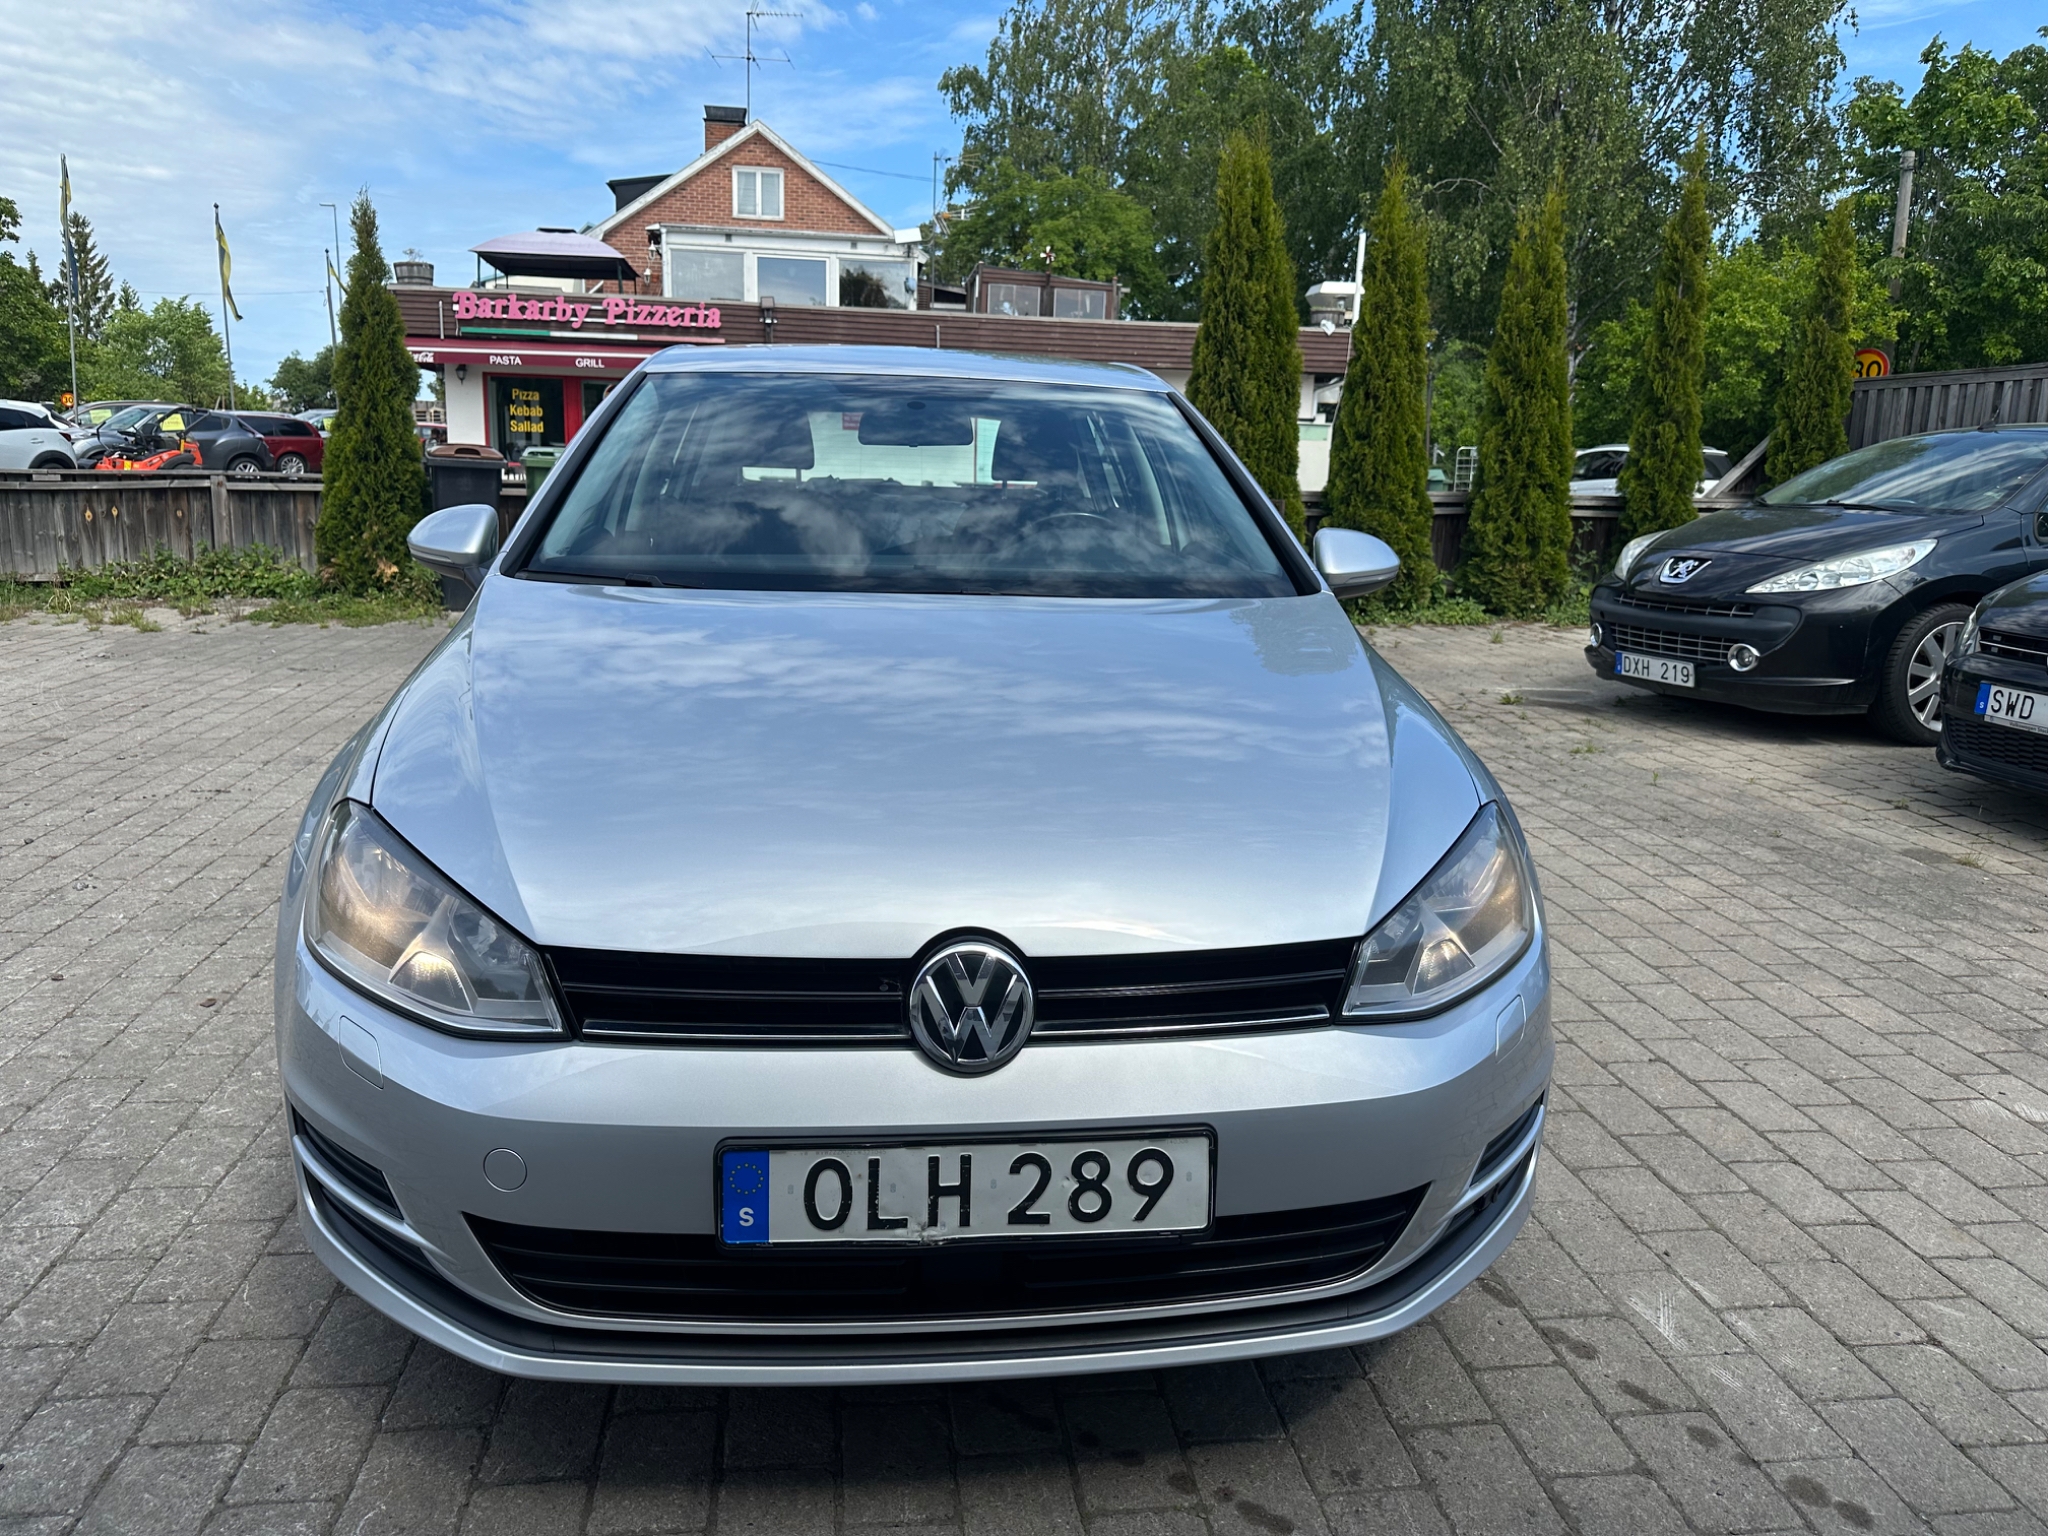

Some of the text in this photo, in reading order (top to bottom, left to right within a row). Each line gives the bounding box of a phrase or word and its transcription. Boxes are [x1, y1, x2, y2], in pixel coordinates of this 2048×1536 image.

[452, 291, 722, 329] Barkarby Pizzeria
[489, 355, 522, 366] PASTA
[575, 357, 605, 369] GRILL
[511, 387, 541, 401] Pizza
[509, 403, 544, 417] Kebab
[510, 419, 544, 433] Sallad
[1623, 655, 1690, 684] DXH 219
[1979, 701, 1985, 709] S
[1990, 689, 2035, 720] SWD
[803, 1146, 1175, 1231] OLH 289
[738, 1206, 755, 1228] S
